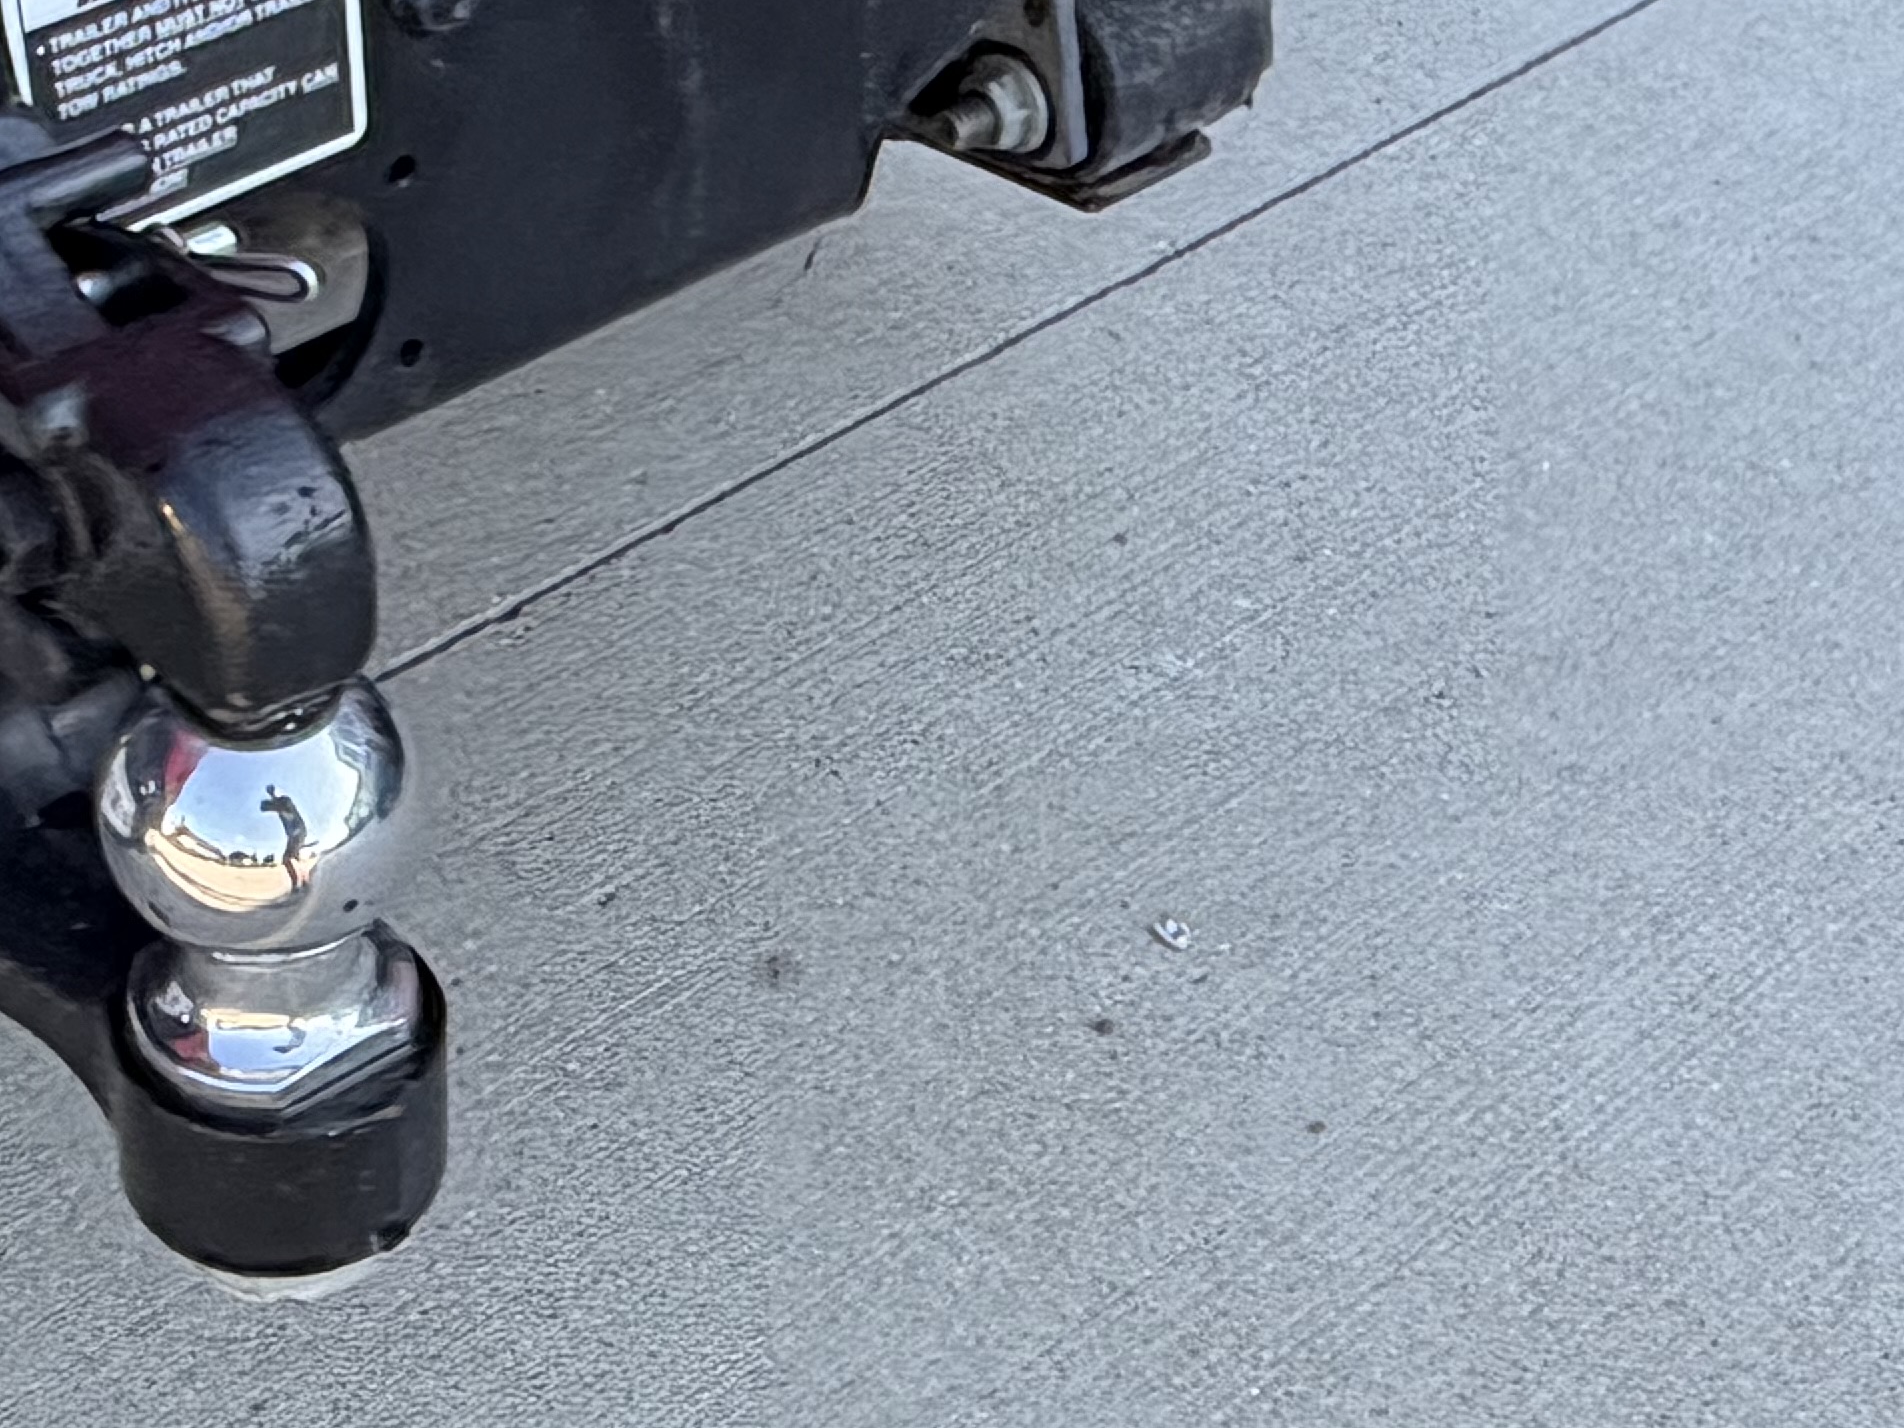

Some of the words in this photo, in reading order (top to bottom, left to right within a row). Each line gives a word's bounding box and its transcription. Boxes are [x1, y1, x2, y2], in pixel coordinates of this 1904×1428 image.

[49, 11, 127, 53] TRAILER
[52, 25, 151, 75] TOGETHER
[125, 38, 181, 70] HITCH
[58, 92, 98, 119] TOW
[154, 86, 229, 126] TRAILER
[231, 67, 274, 95] THAT
[154, 114, 212, 149] RATED
[215, 80, 296, 124] CAPACITY
